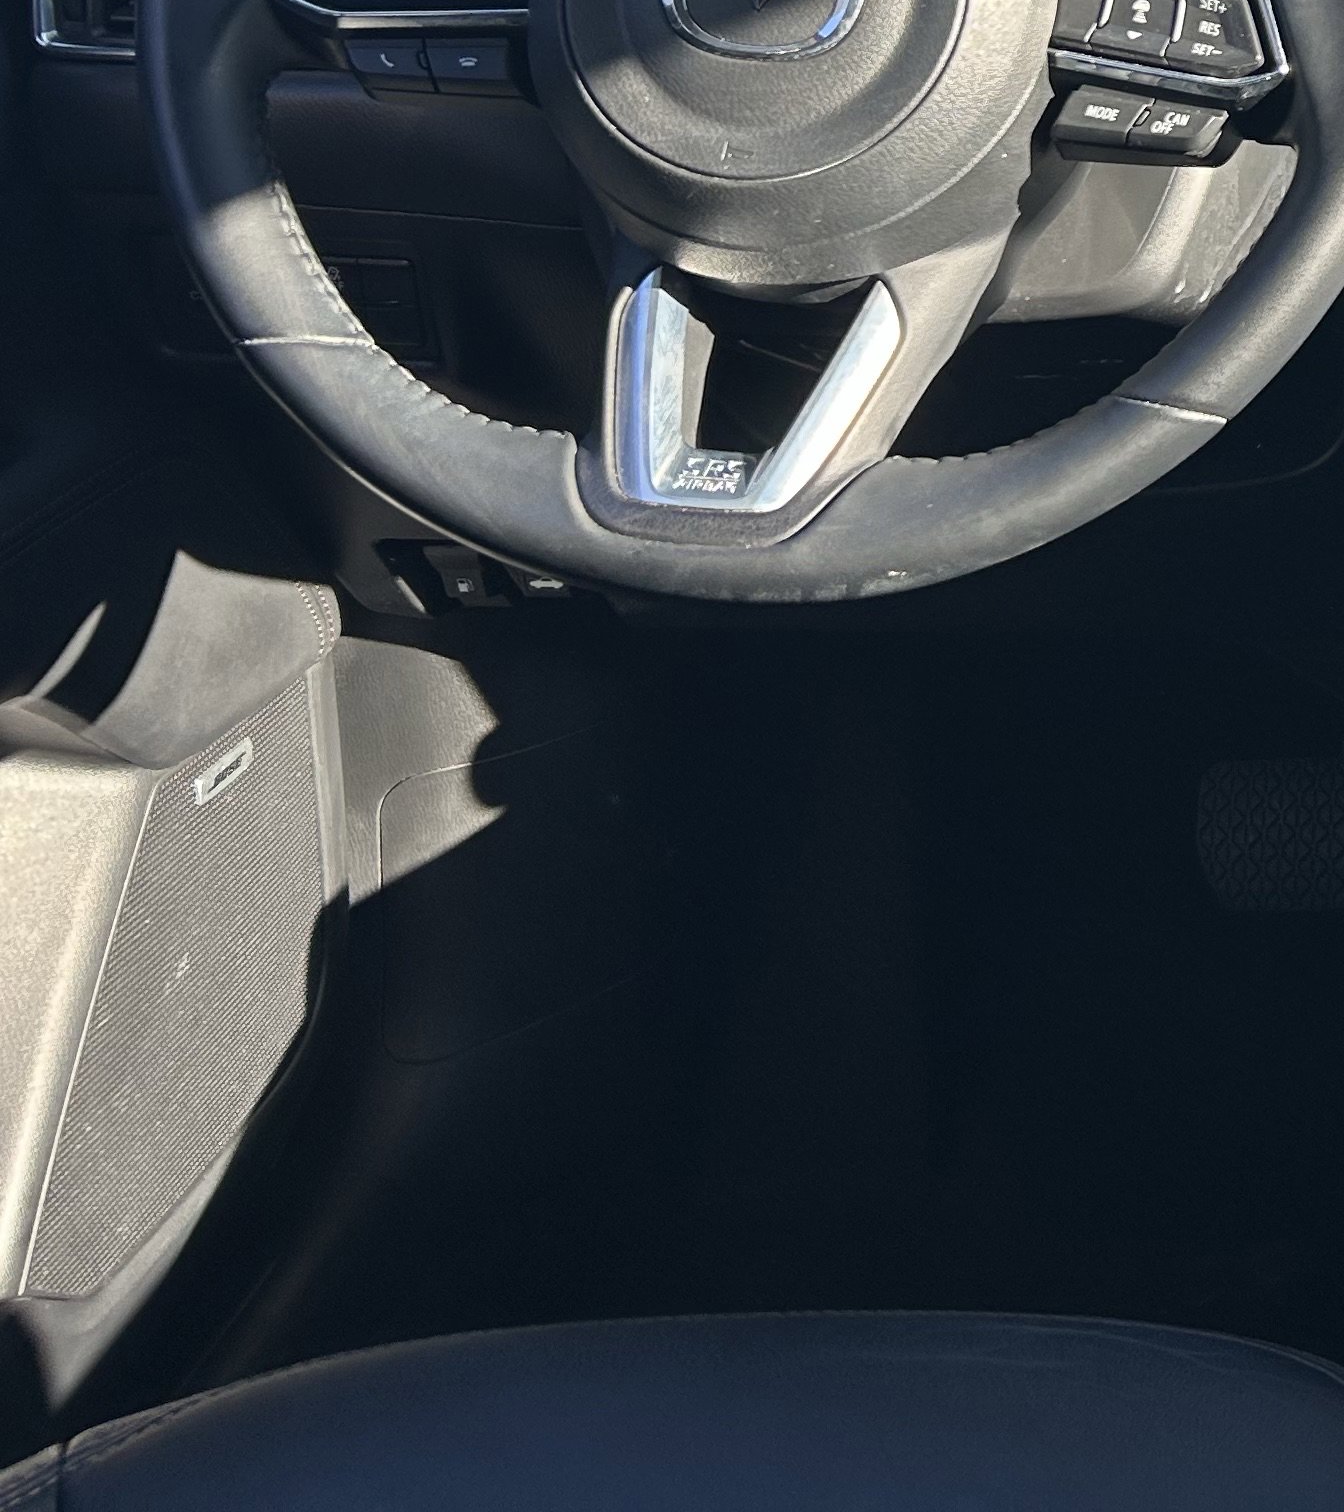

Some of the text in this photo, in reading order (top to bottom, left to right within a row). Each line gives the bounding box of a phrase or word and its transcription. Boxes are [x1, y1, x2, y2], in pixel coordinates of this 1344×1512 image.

[1198, 20, 1222, 37] RES
[1084, 104, 1121, 122] MODE
[1163, 111, 1191, 127] CAN
[1150, 120, 1176, 135] OFF
